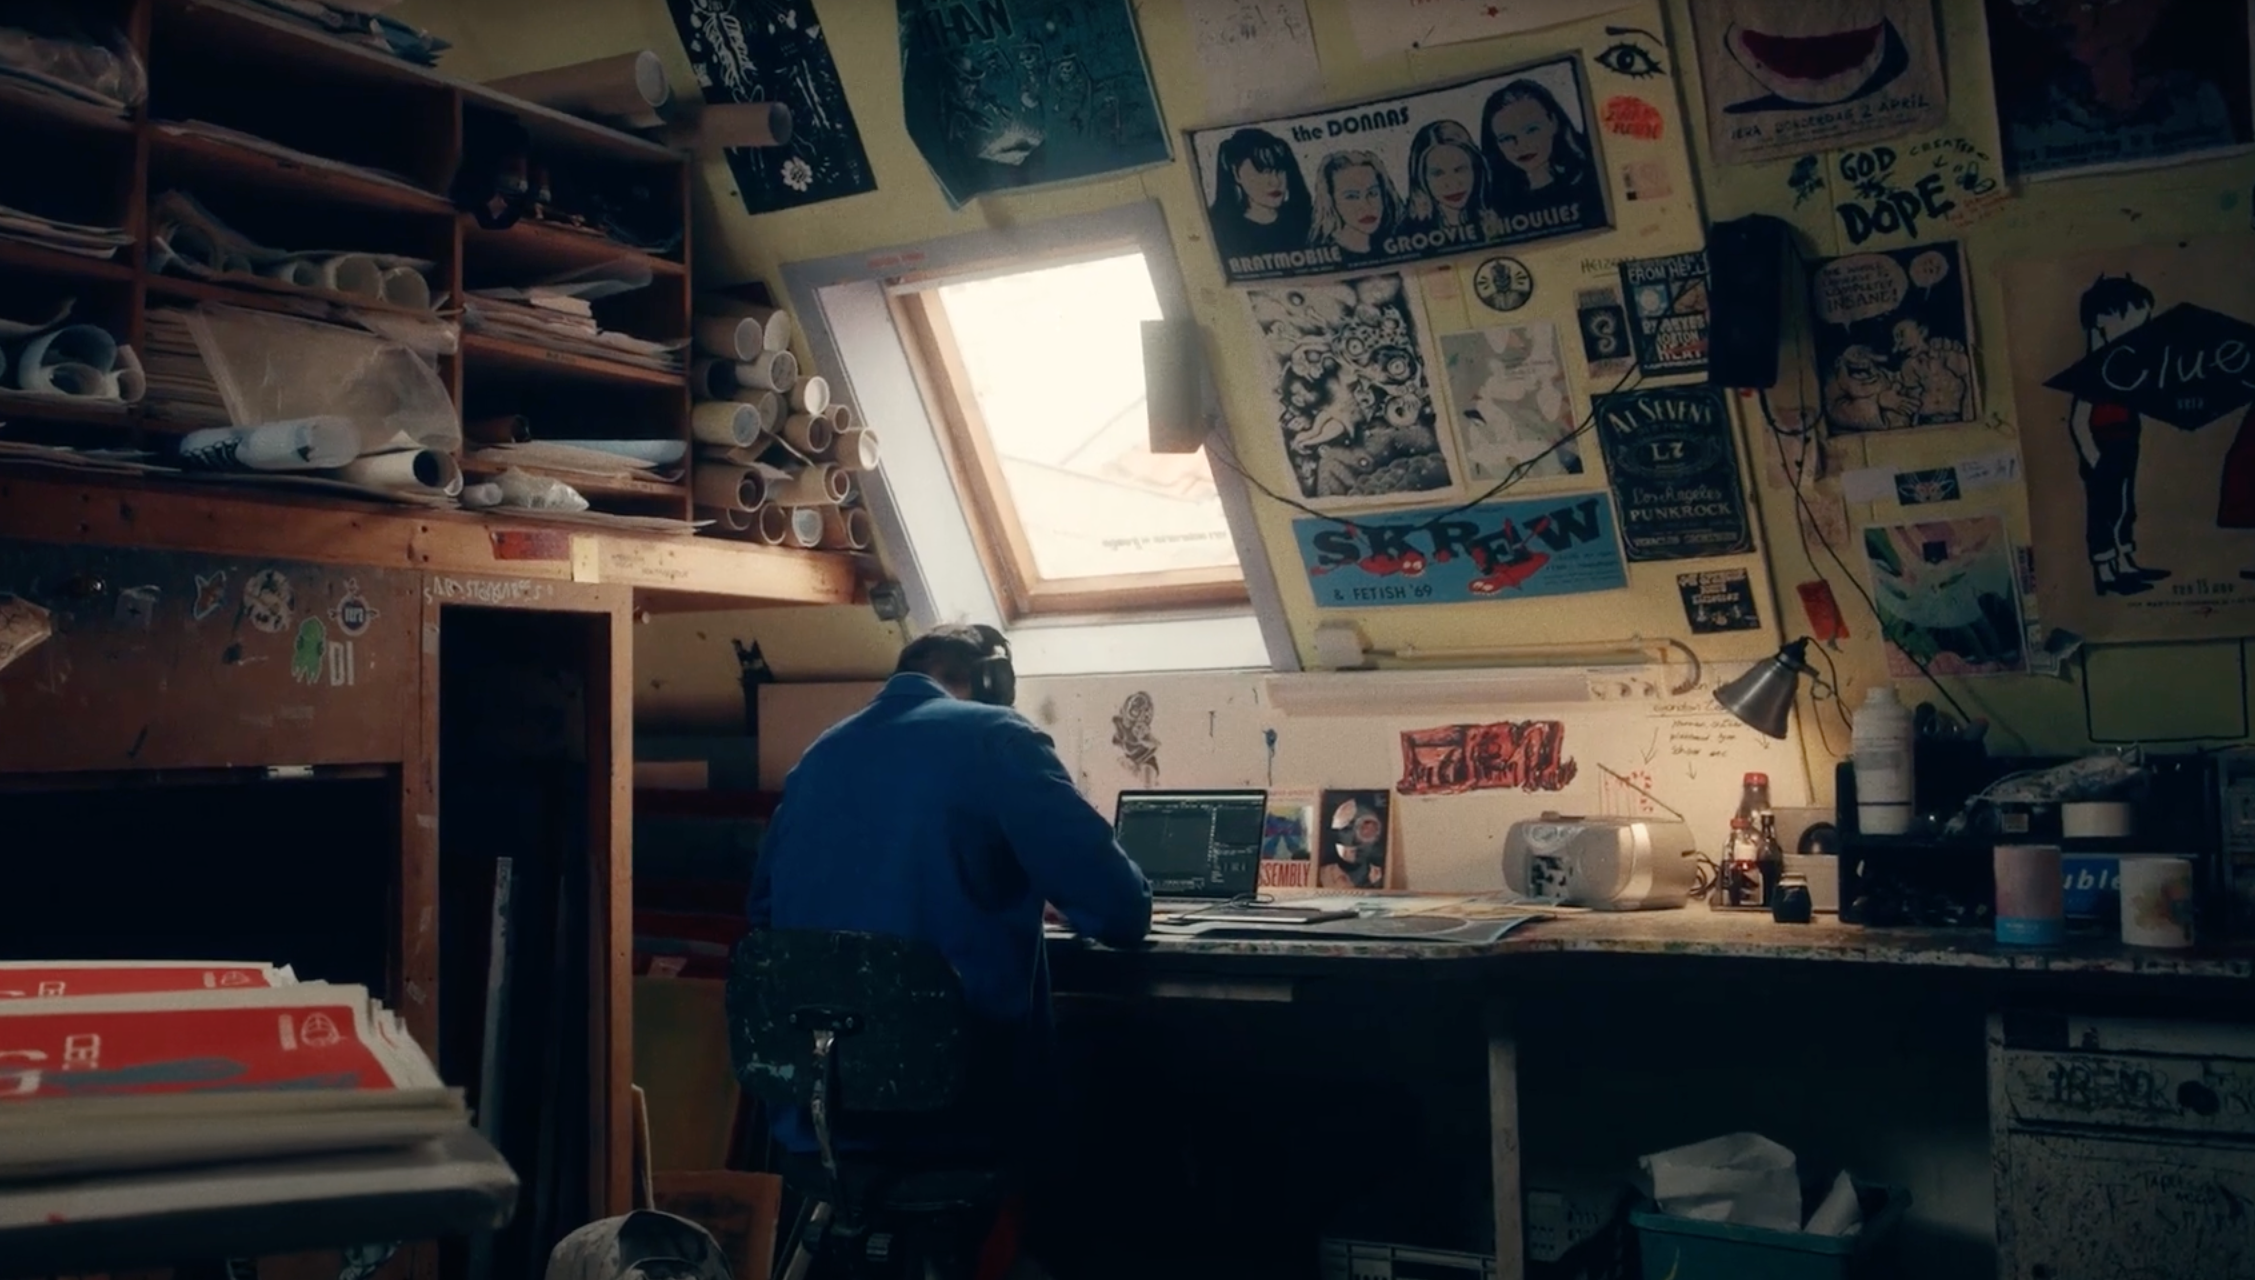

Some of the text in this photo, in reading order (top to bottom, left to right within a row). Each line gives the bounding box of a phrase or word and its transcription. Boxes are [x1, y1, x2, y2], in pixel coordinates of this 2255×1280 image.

[1292, 107, 1409, 142] the DONNAS
[1840, 146, 1897, 181] GOD
[1836, 173, 1956, 246] DOPE
[1382, 223, 1478, 256] GROOVIE
[1228, 244, 1343, 274] BRATMOBILE
[2101, 339, 2255, 393] Clue
[1629, 502, 1732, 522] PUNKROCK
[1353, 586, 1406, 601] FETISH
